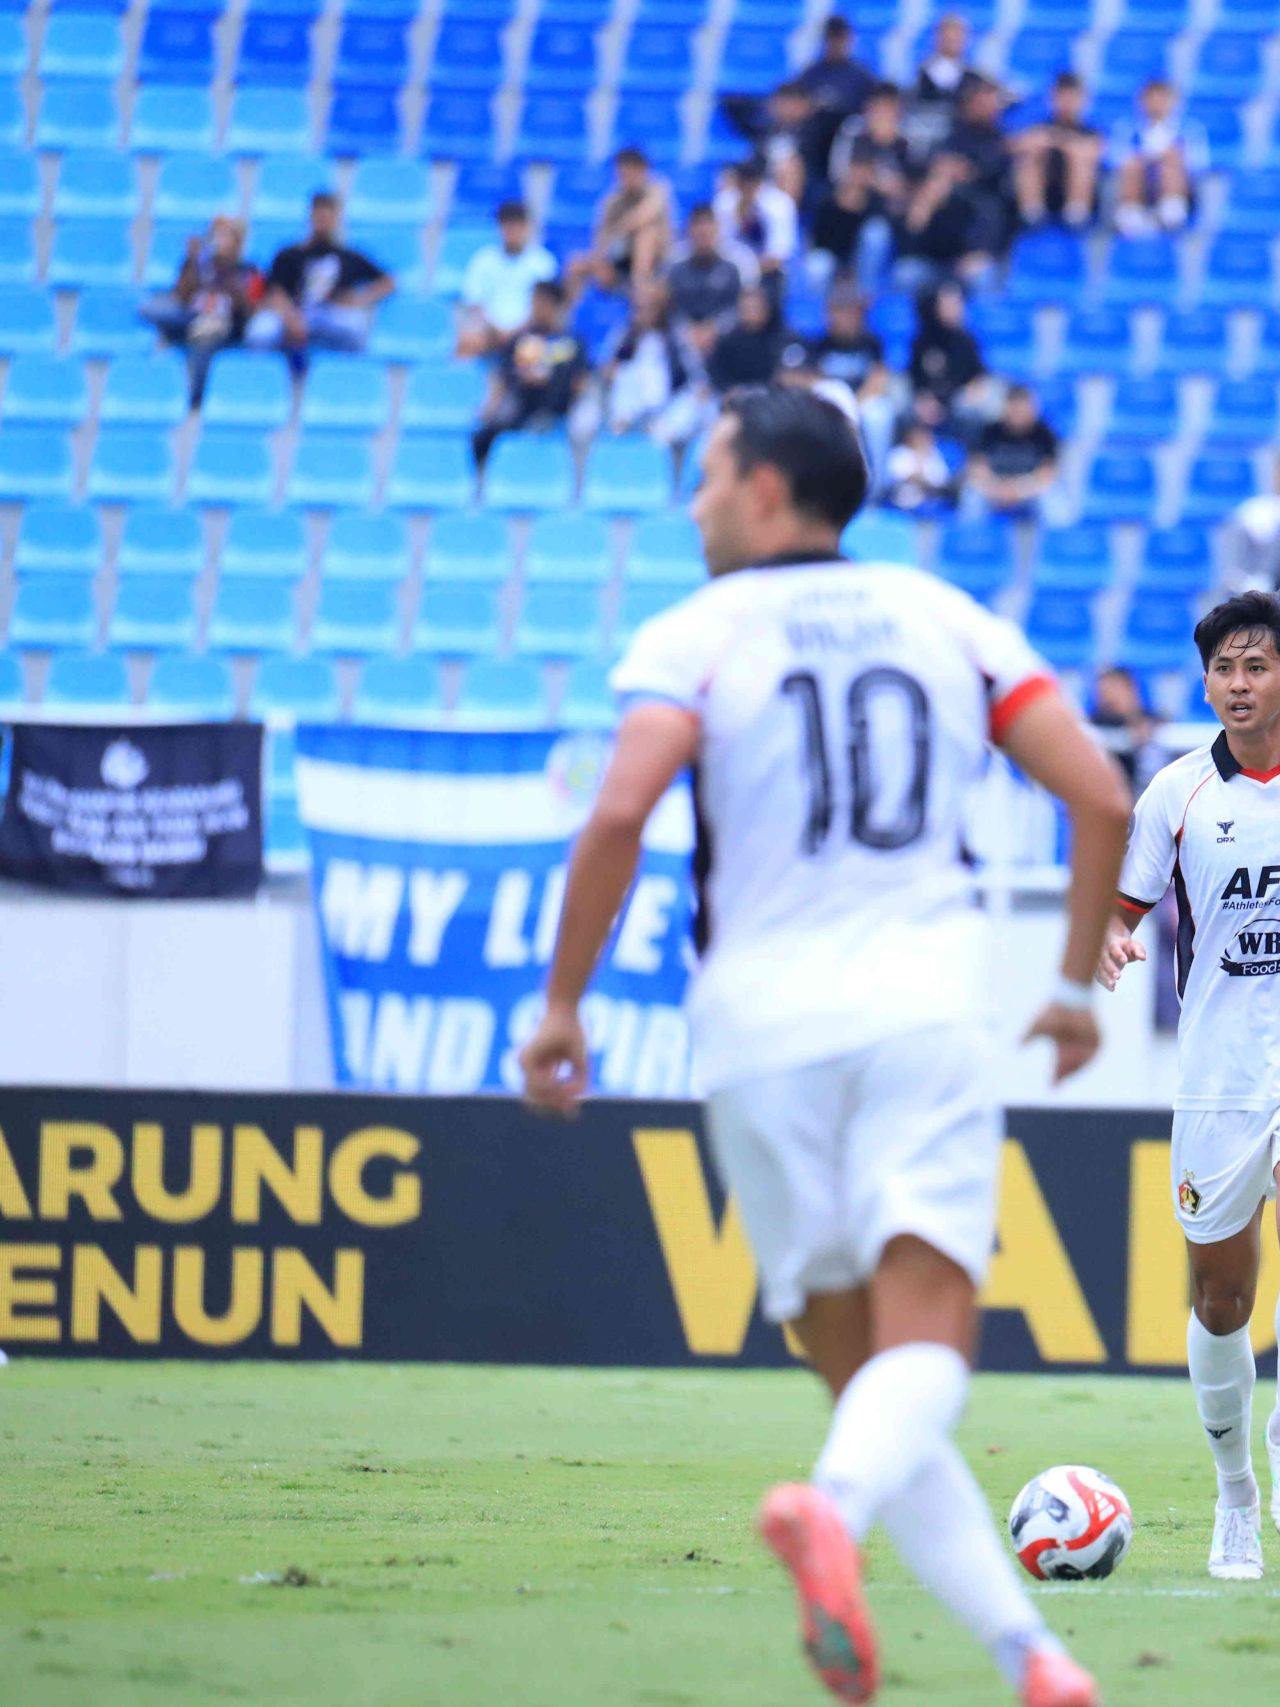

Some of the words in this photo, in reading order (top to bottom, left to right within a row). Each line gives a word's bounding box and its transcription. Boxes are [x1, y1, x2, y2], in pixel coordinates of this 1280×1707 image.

[781, 666, 928, 855] 10
[321, 858, 469, 967] MY
[483, 864, 678, 975] LIE
